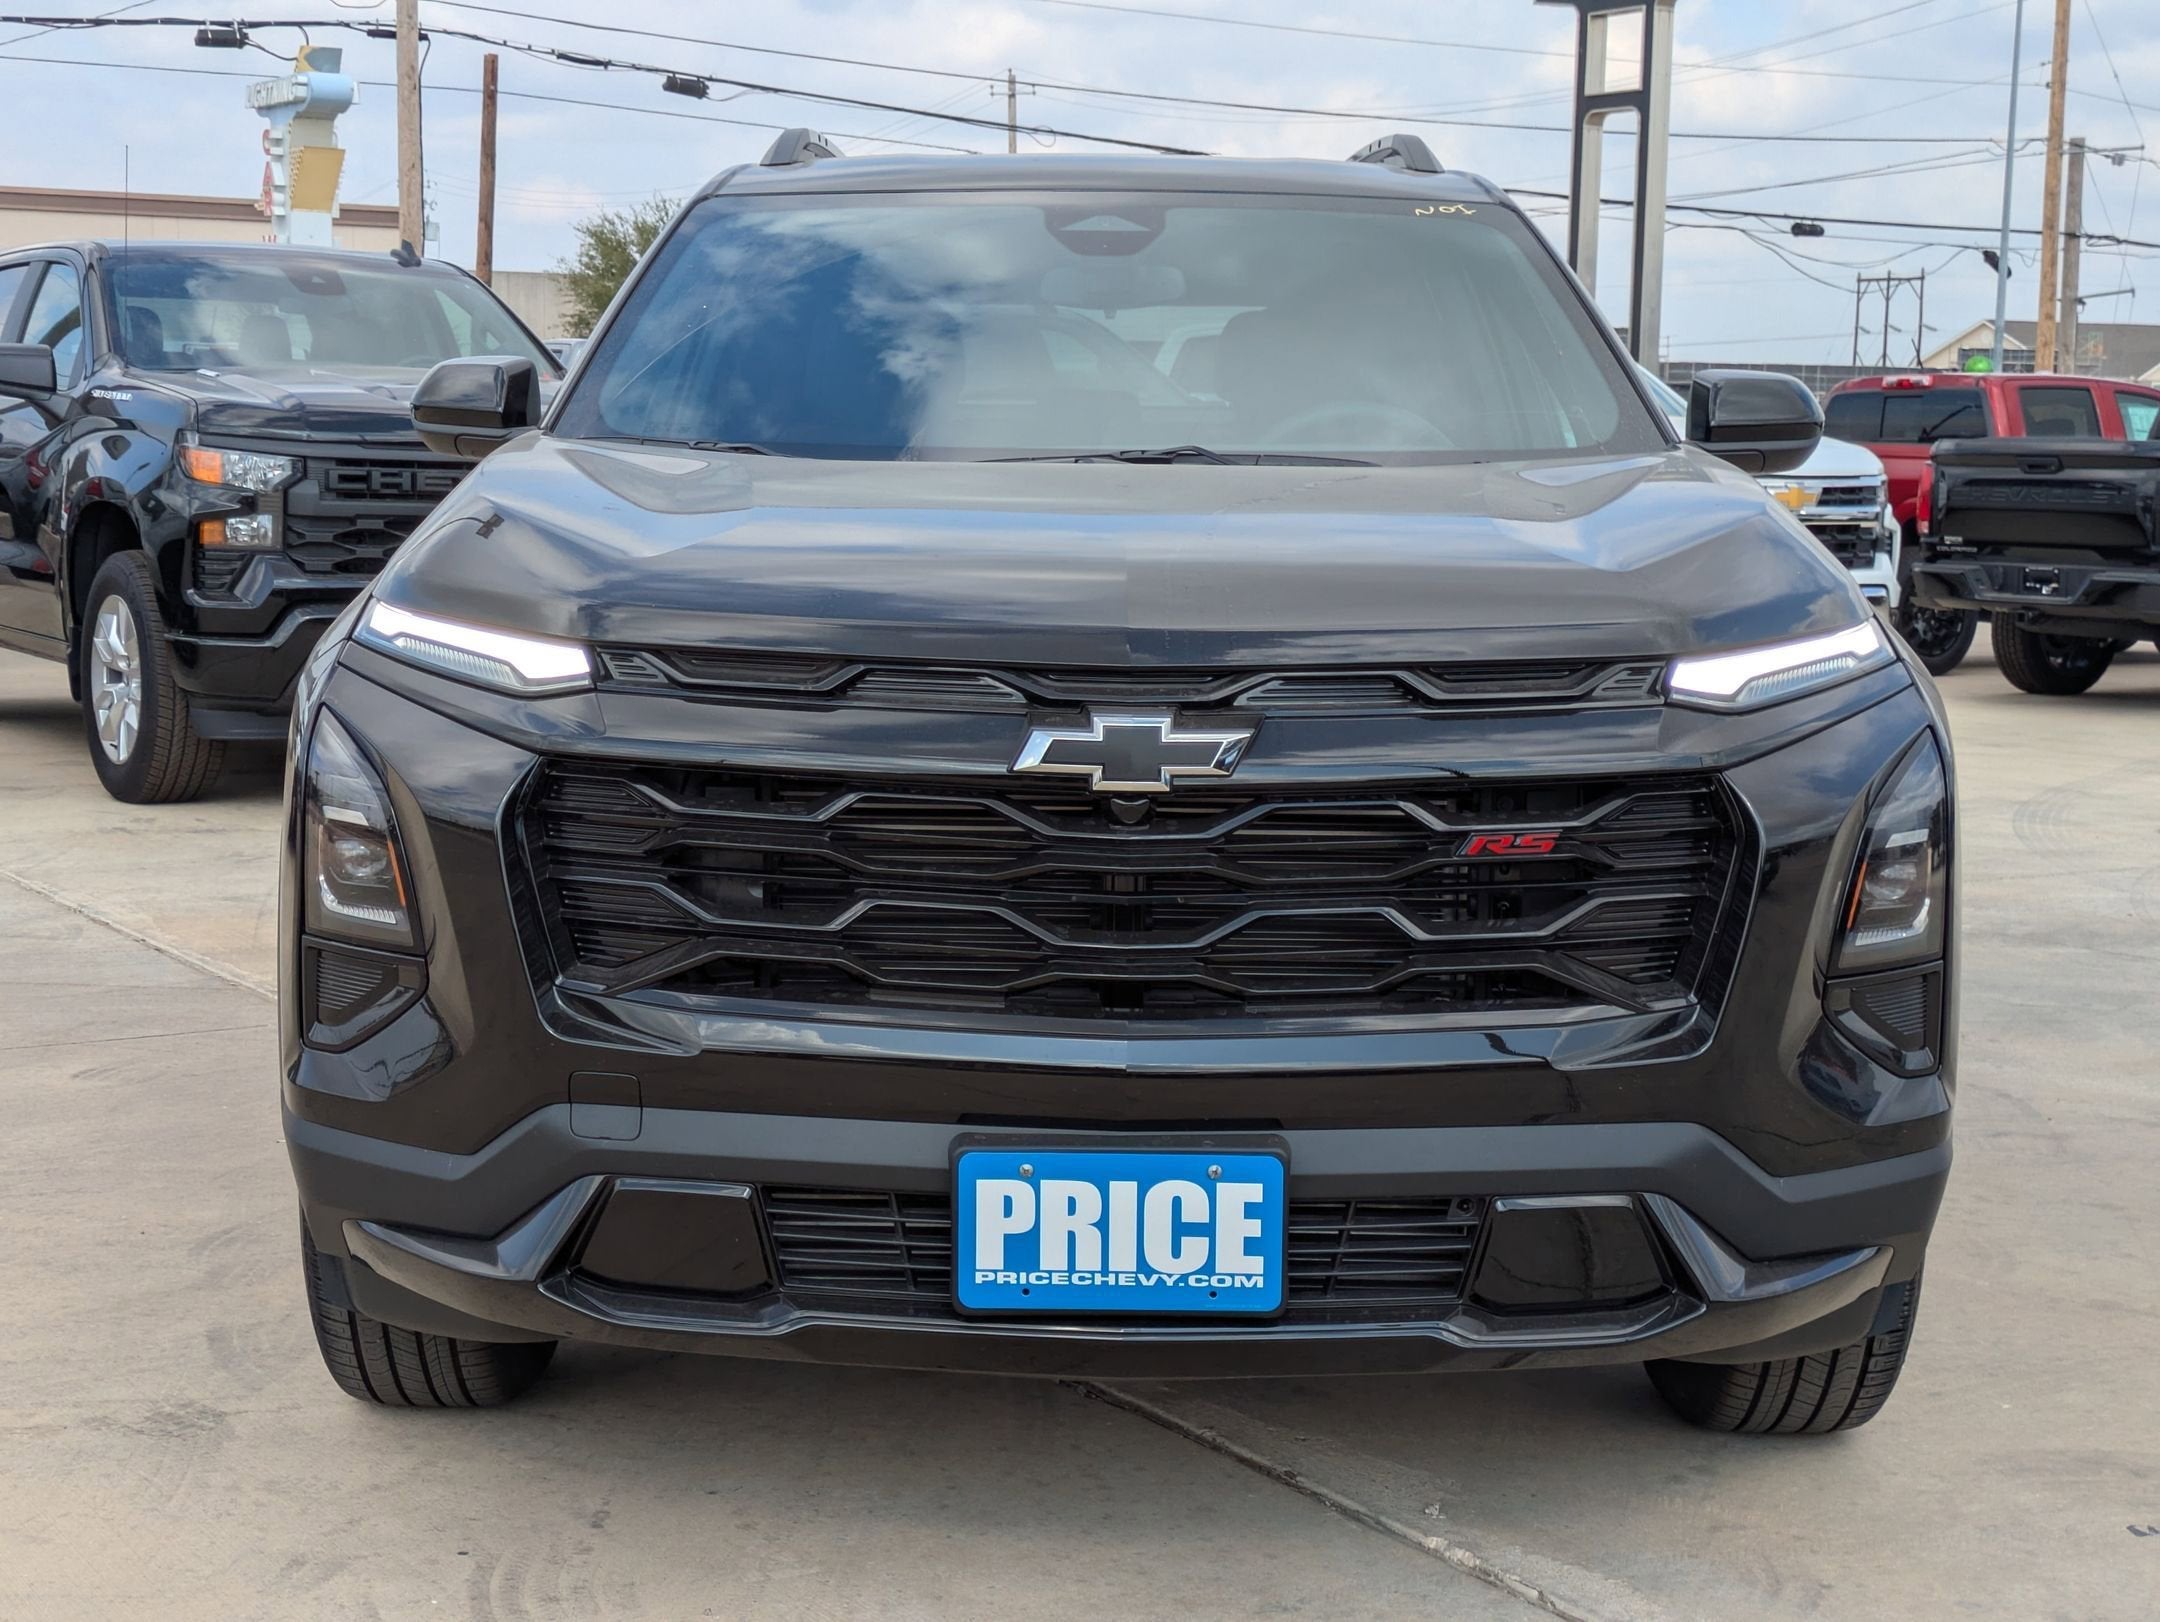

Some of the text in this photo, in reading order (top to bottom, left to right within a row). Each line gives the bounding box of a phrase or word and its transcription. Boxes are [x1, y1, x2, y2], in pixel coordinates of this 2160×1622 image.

[1460, 832, 1561, 856] RS
[975, 1178, 1264, 1275] PRICE
[975, 1271, 1264, 1288] PRICECHEVY.COM
